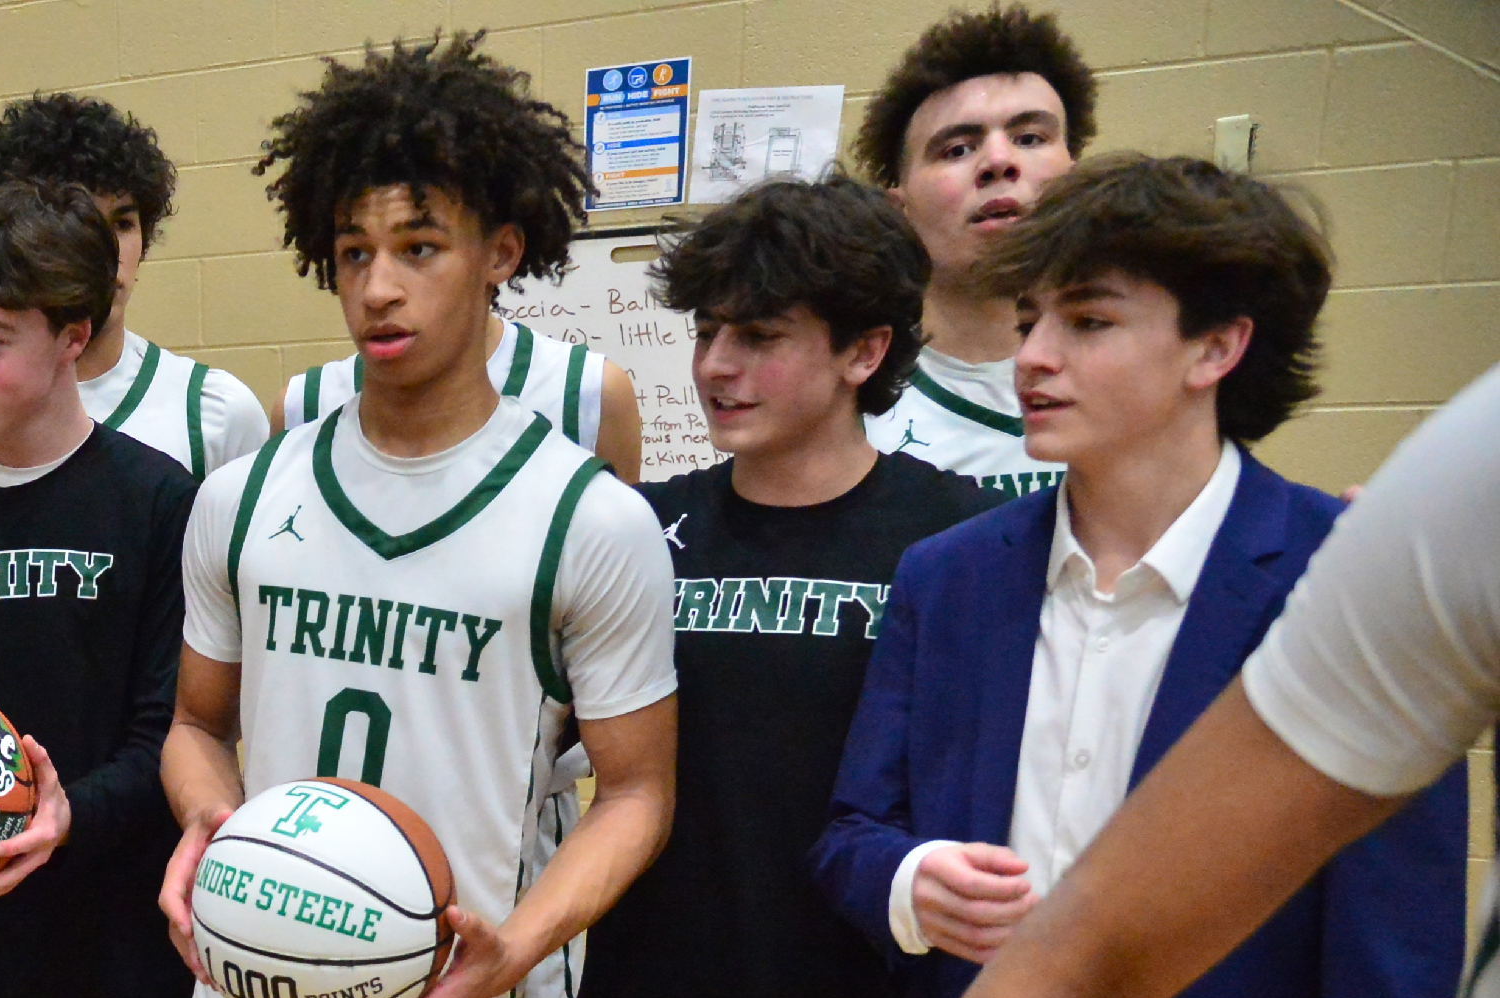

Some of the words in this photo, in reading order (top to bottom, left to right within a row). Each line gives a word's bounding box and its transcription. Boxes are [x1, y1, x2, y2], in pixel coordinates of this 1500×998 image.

[627, 90, 649, 100] HIDE
[653, 86, 680, 98] FIGHT
[619, 321, 677, 347] little
[650, 415, 682, 431] from
[258, 584, 503, 683] TRINITY
[317, 687, 392, 789] 0
[256, 878, 382, 942] STEELE
